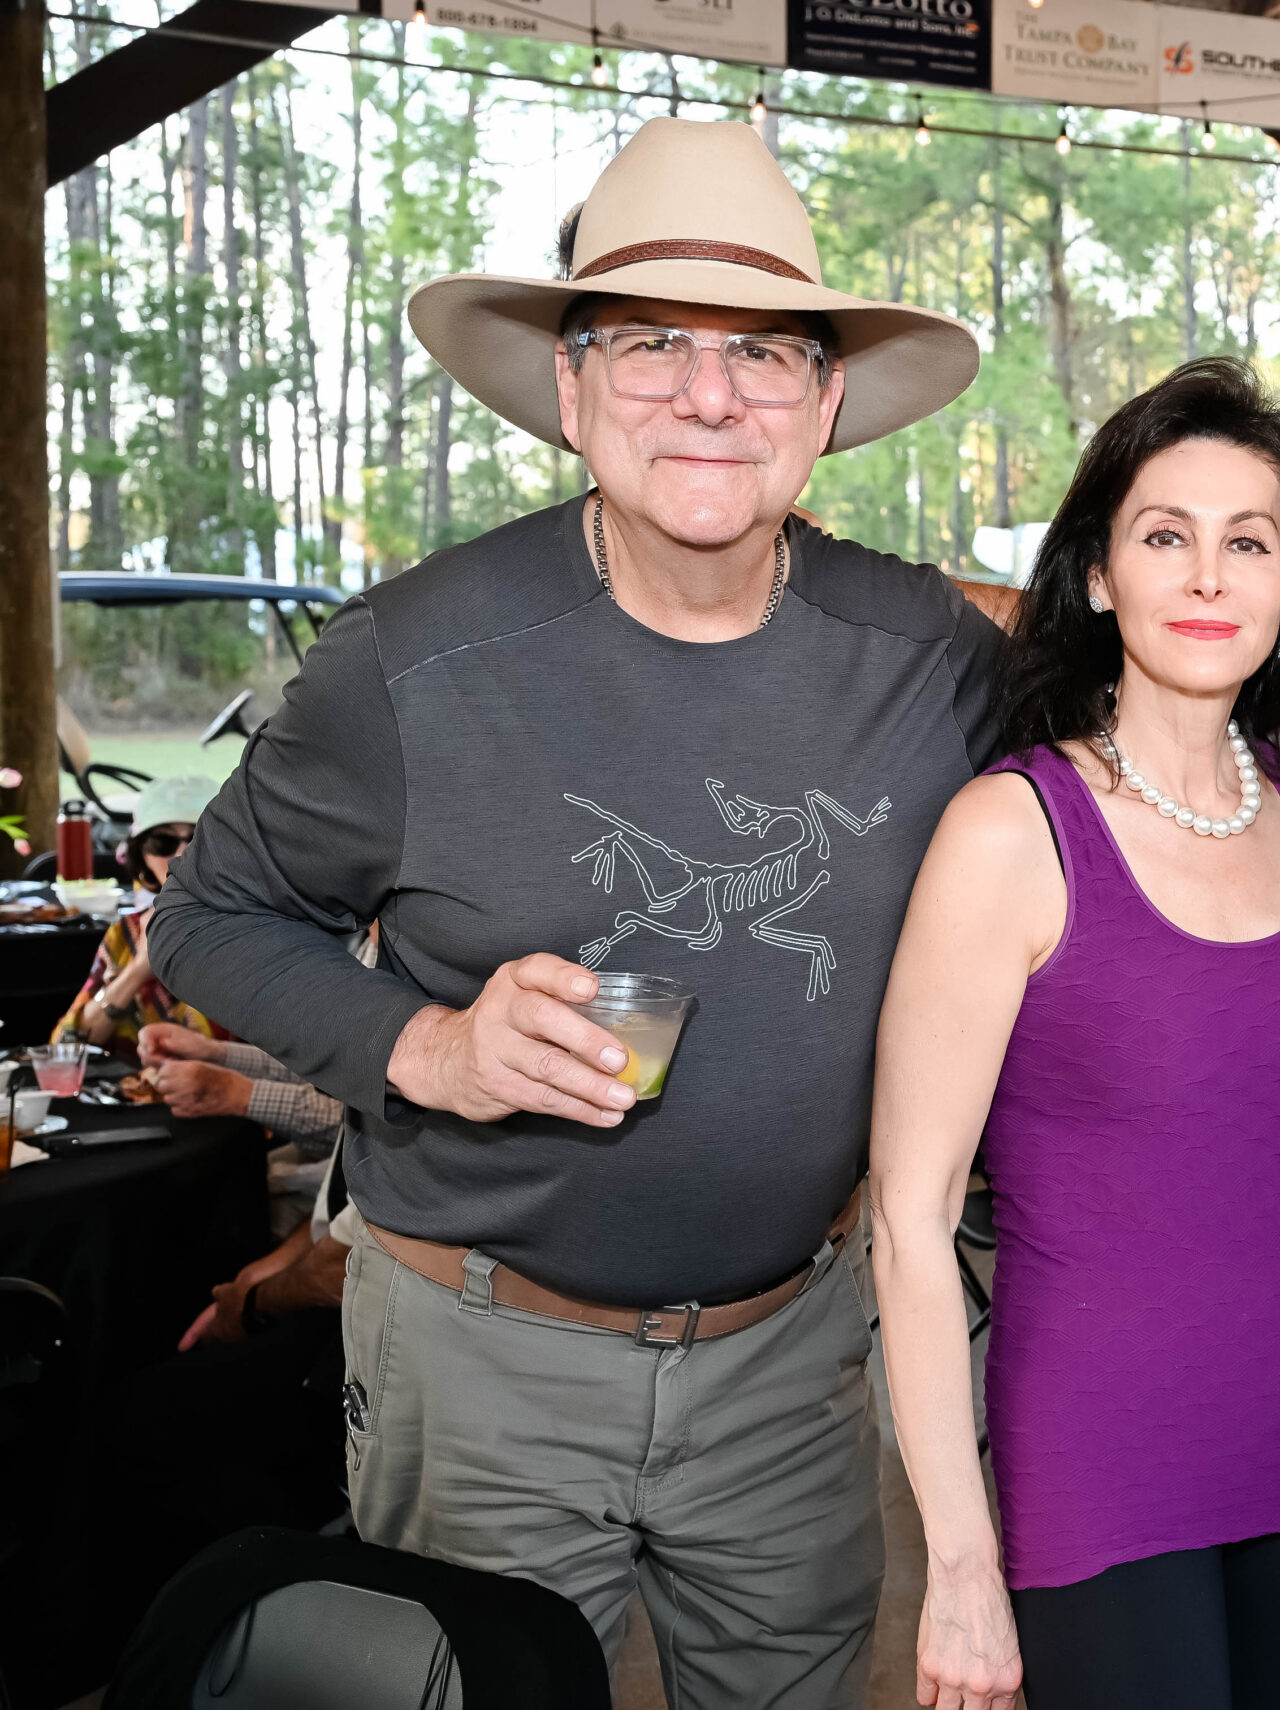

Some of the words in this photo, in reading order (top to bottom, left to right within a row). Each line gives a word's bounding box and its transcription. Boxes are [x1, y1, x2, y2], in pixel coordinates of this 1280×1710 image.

[1017, 23, 1073, 44] TAMPA
[1107, 33, 1137, 52] BAY
[1005, 44, 1057, 67] TRUST
[1062, 51, 1150, 76] COMPANY
